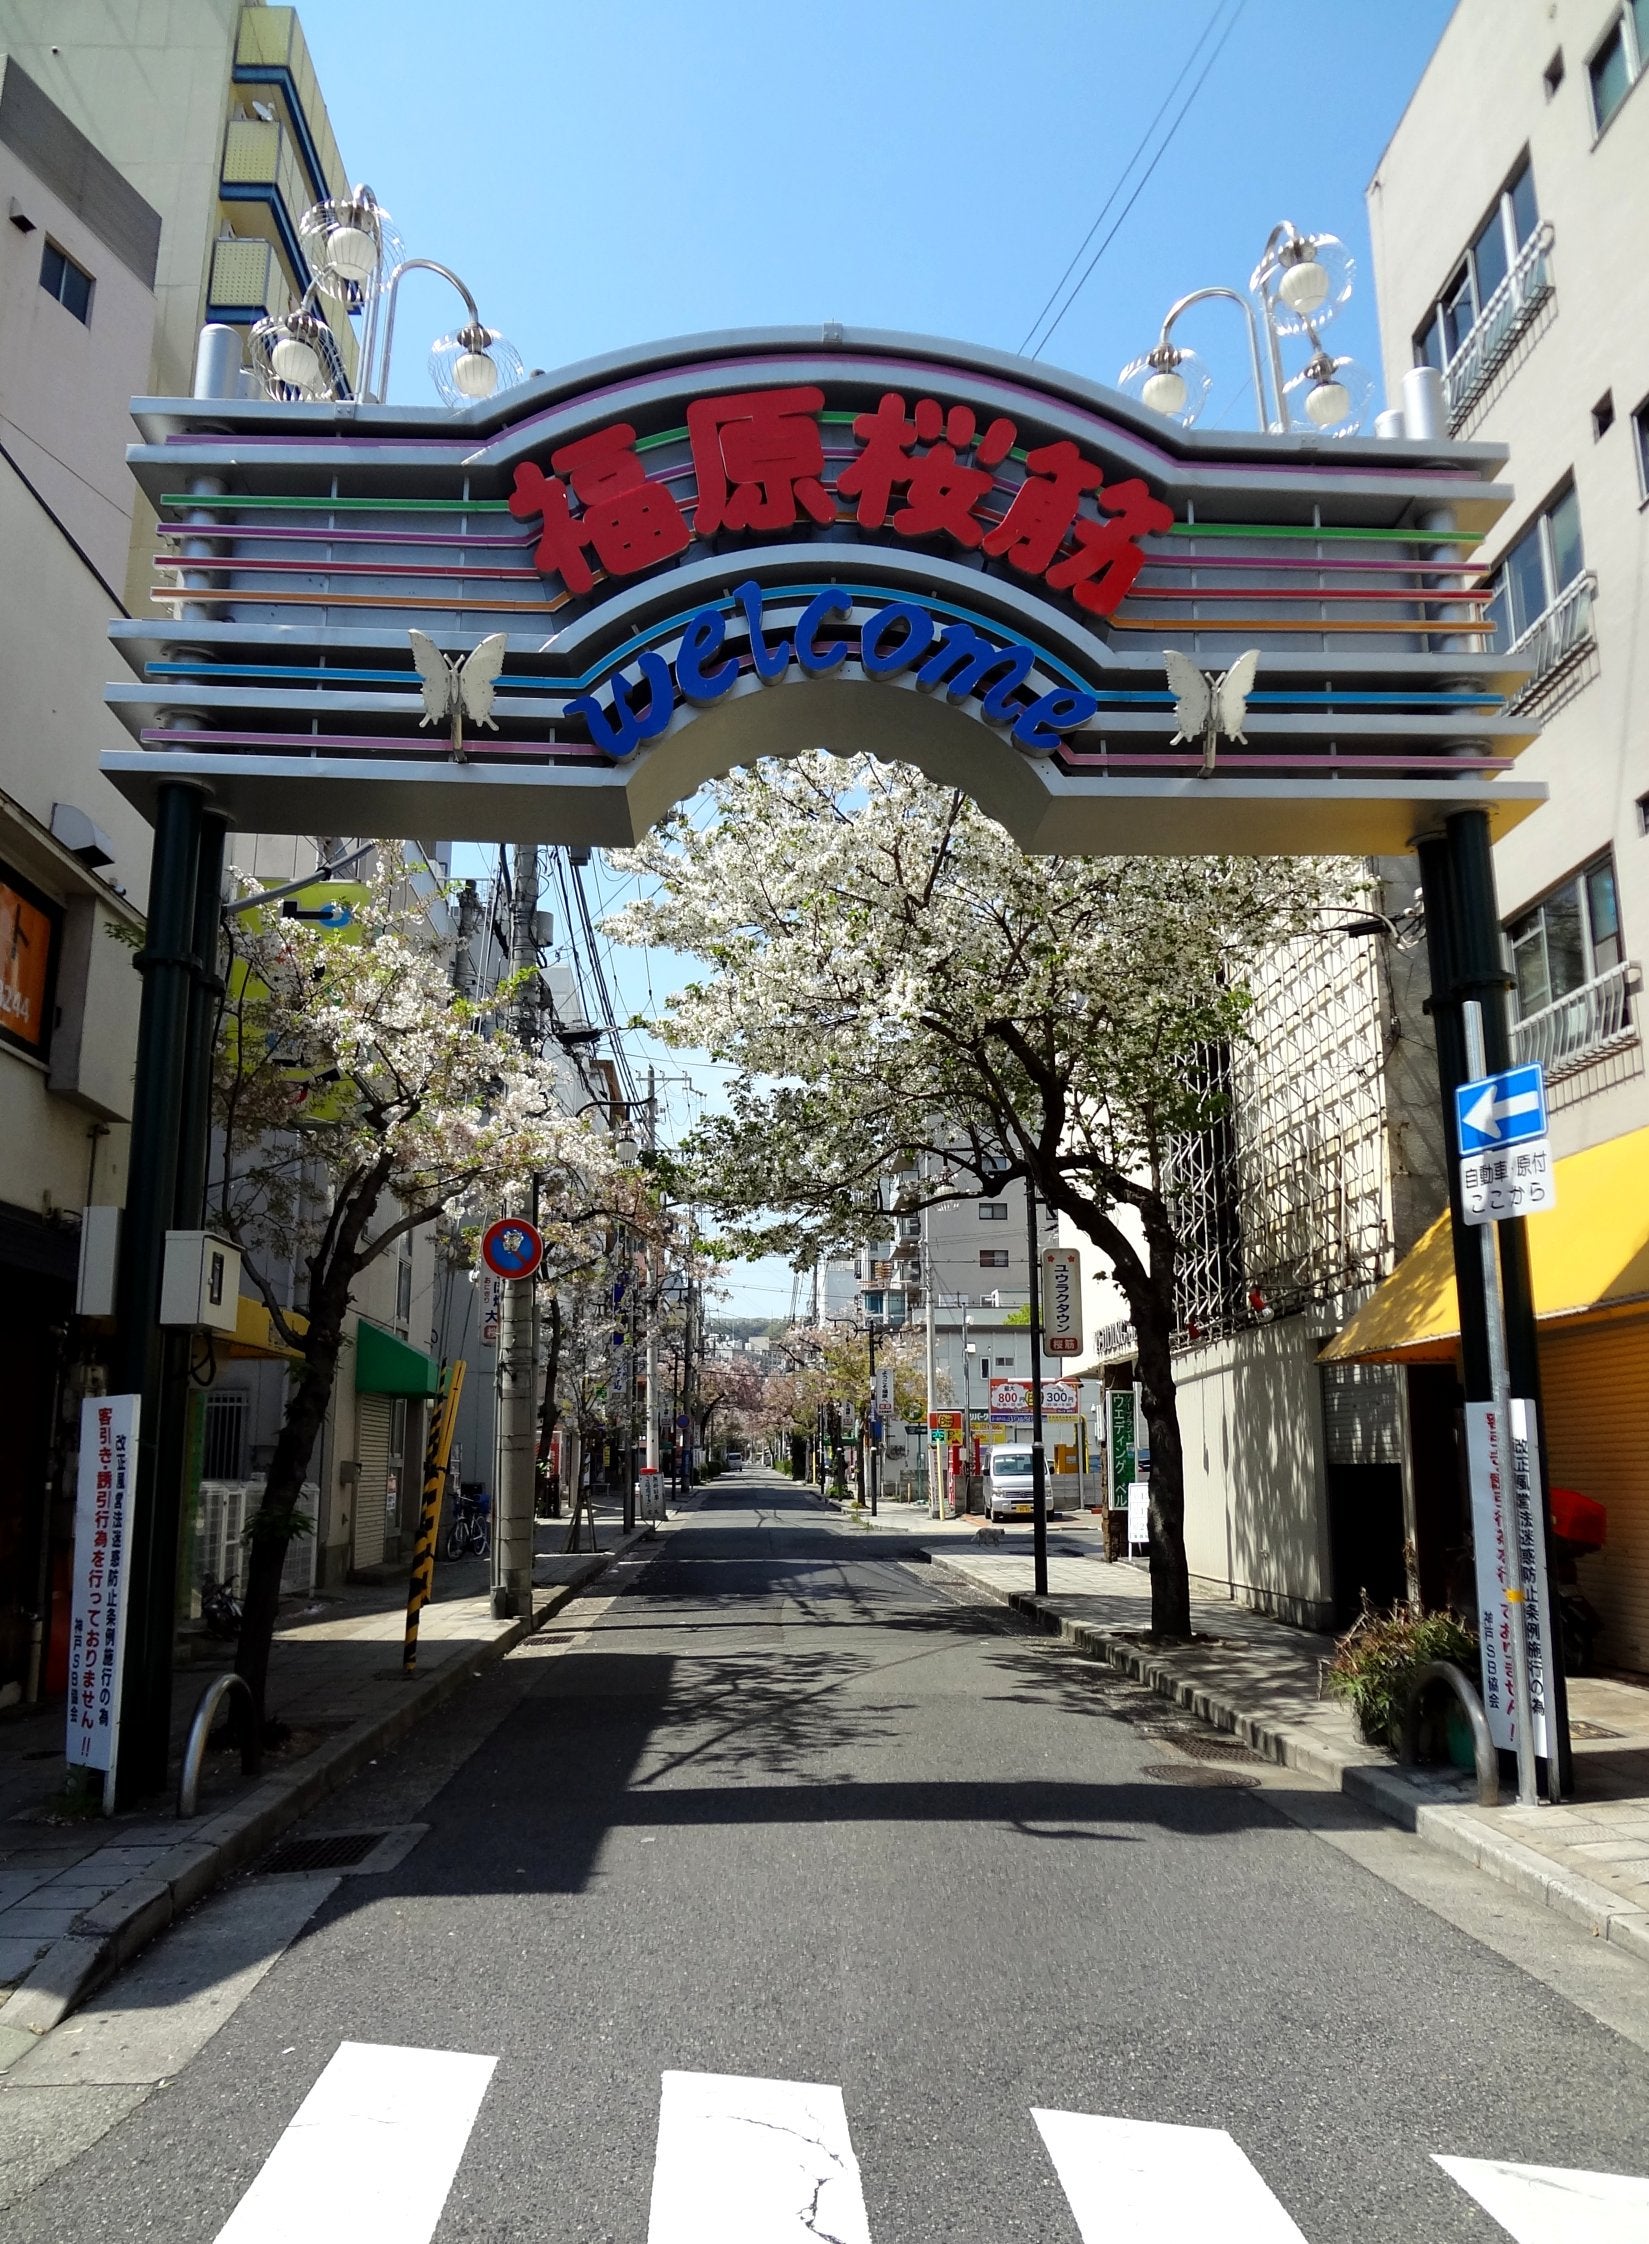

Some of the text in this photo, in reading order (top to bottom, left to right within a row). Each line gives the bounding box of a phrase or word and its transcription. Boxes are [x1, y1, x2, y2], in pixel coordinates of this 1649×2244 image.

[508, 386, 1174, 617] 福原桜筋
[563, 580, 1099, 765] welcome
[1464, 1149, 1548, 1189] 自動車・原付
[1471, 1181, 1546, 1214] ここから
[1054, 1264, 1071, 1334] ユウラクタウン
[1053, 1338, 1075, 1350] 桜筋
[1112, 1394, 1128, 1507] ウエディング ベル
